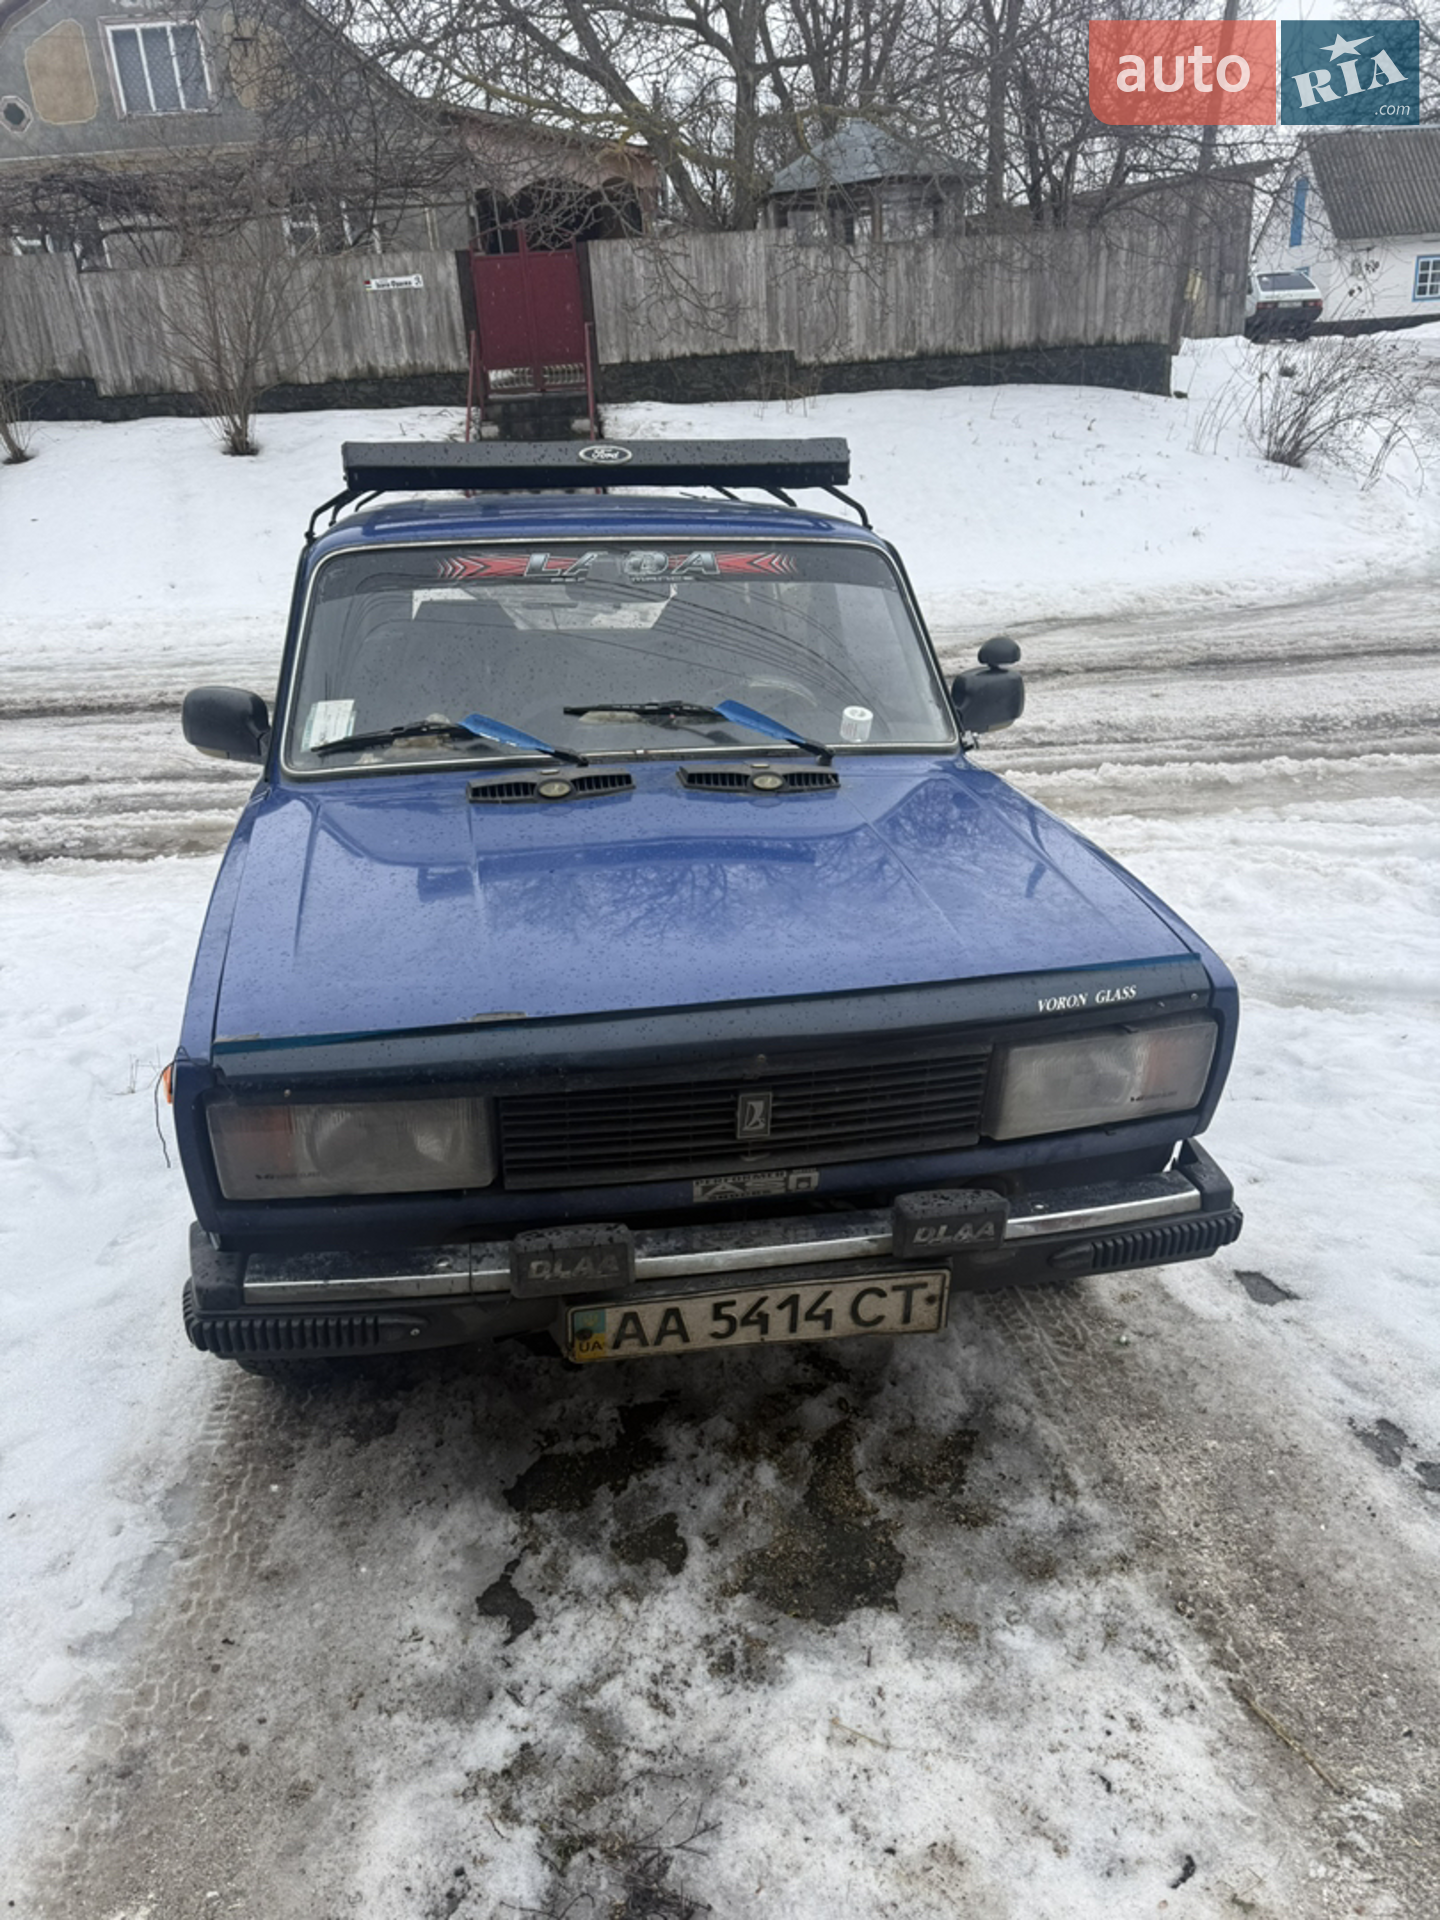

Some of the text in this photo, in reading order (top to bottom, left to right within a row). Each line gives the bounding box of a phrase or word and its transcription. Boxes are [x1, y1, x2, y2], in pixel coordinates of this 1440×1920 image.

[592, 448, 620, 460] Ford
[1037, 985, 1137, 1012] VORON GLASS
[912, 1221, 995, 1246] DLAA
[527, 1254, 620, 1281] DLAA
[612, 1281, 929, 1350] AA 5414 CT
[578, 1340, 604, 1353] UA
